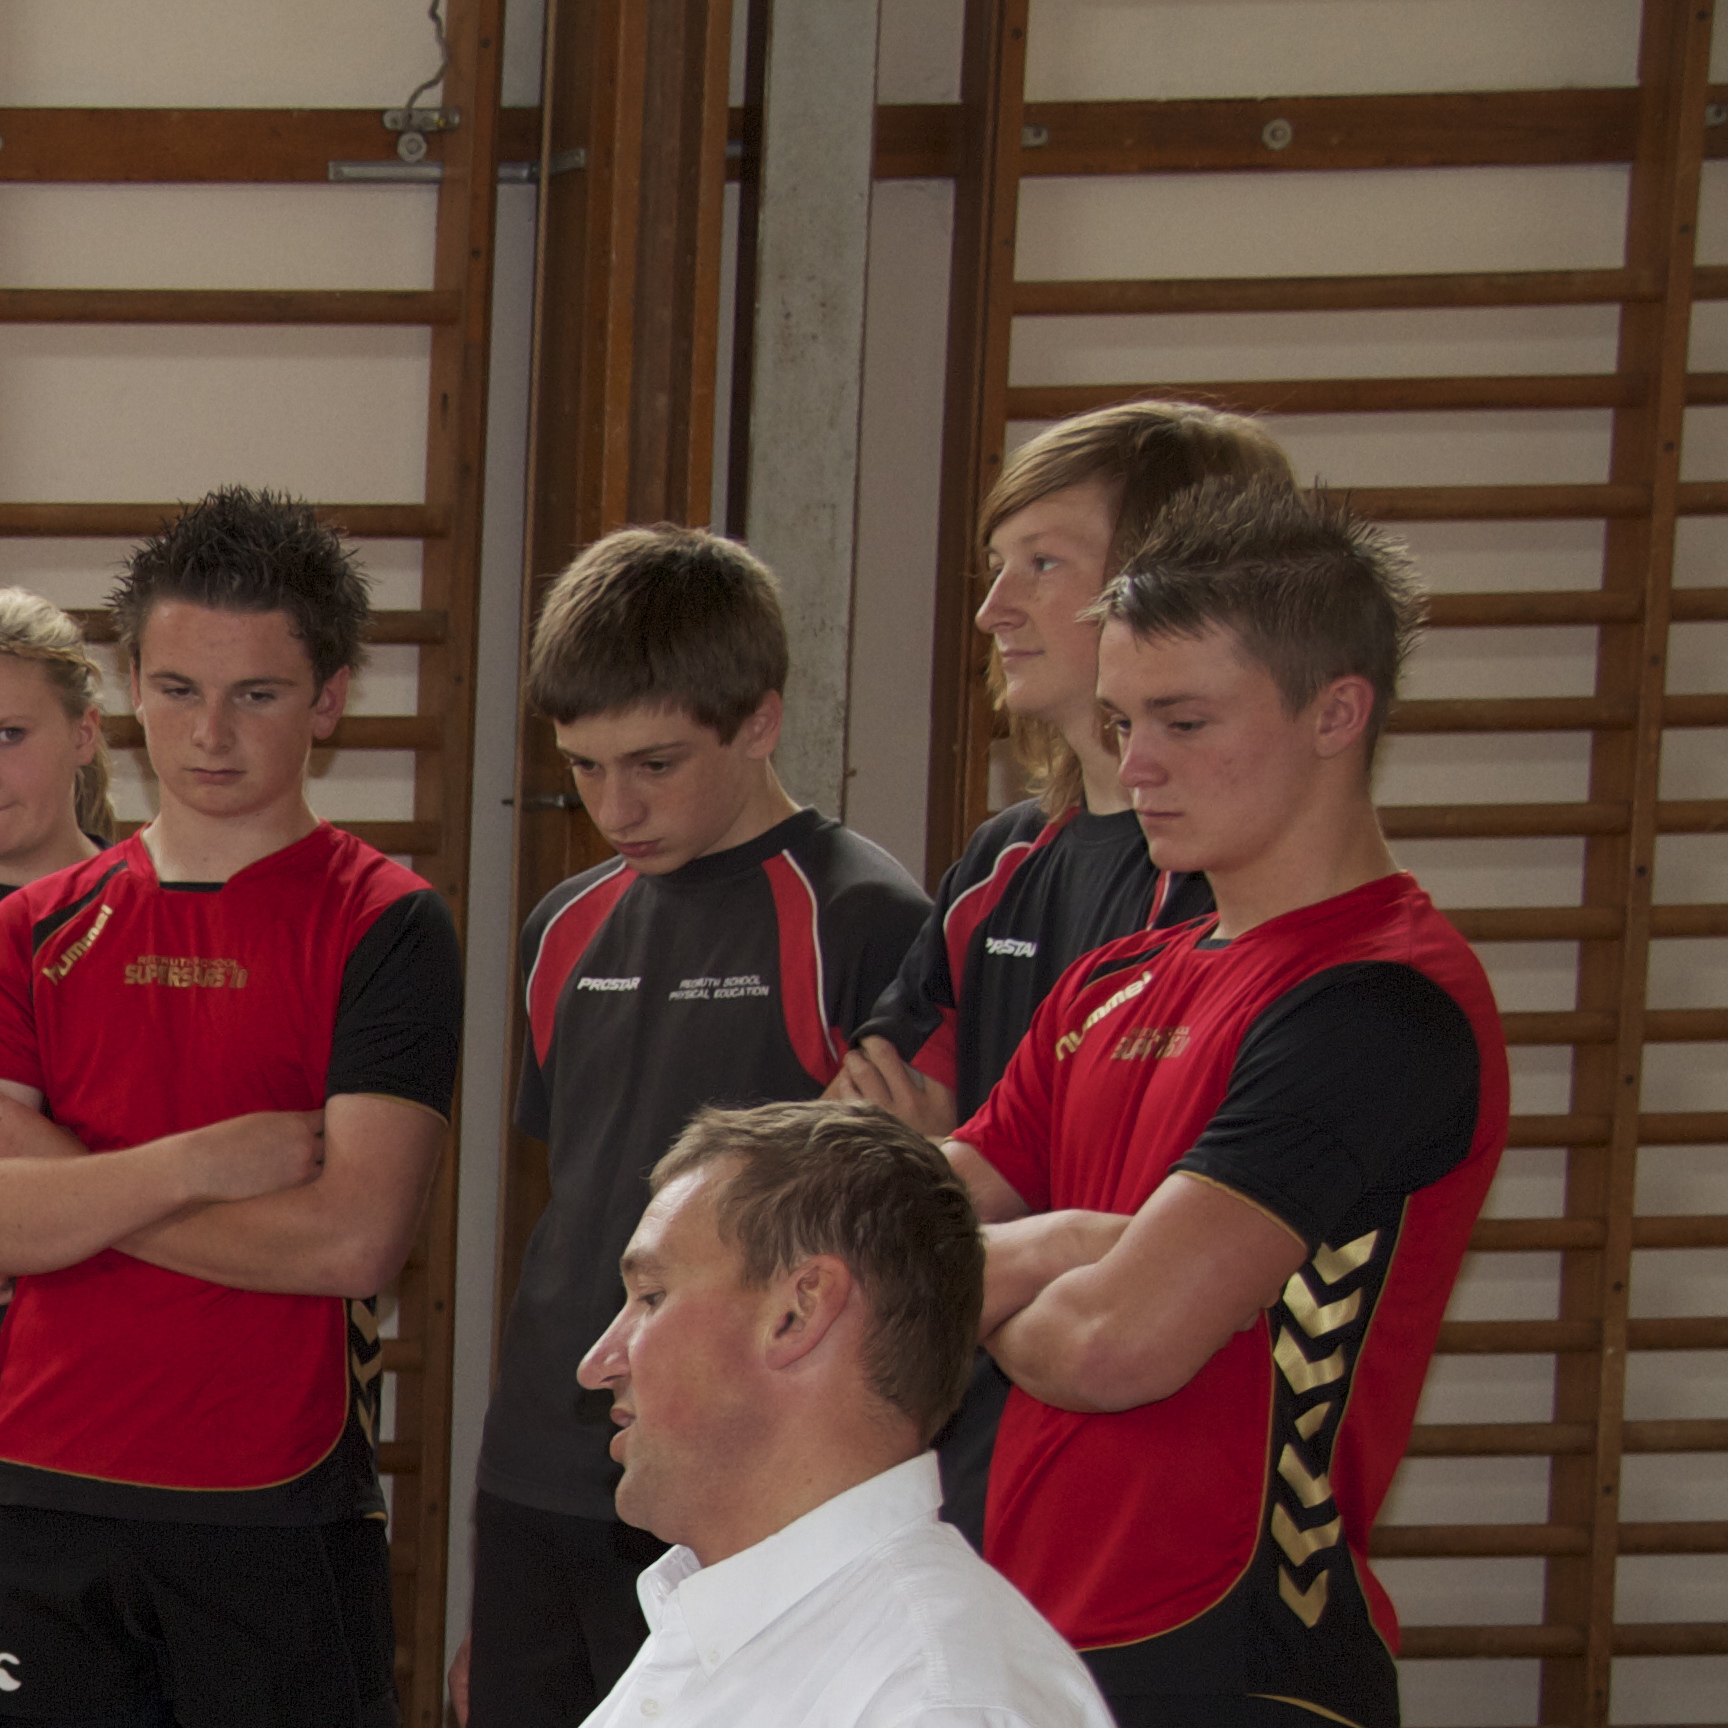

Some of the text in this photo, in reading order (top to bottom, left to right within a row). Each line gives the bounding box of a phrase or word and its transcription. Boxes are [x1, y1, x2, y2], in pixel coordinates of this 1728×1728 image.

[577, 976, 642, 992] PROSTAR
[723, 975, 761, 988] SCHOOL
[713, 985, 770, 999] EDUCATION
